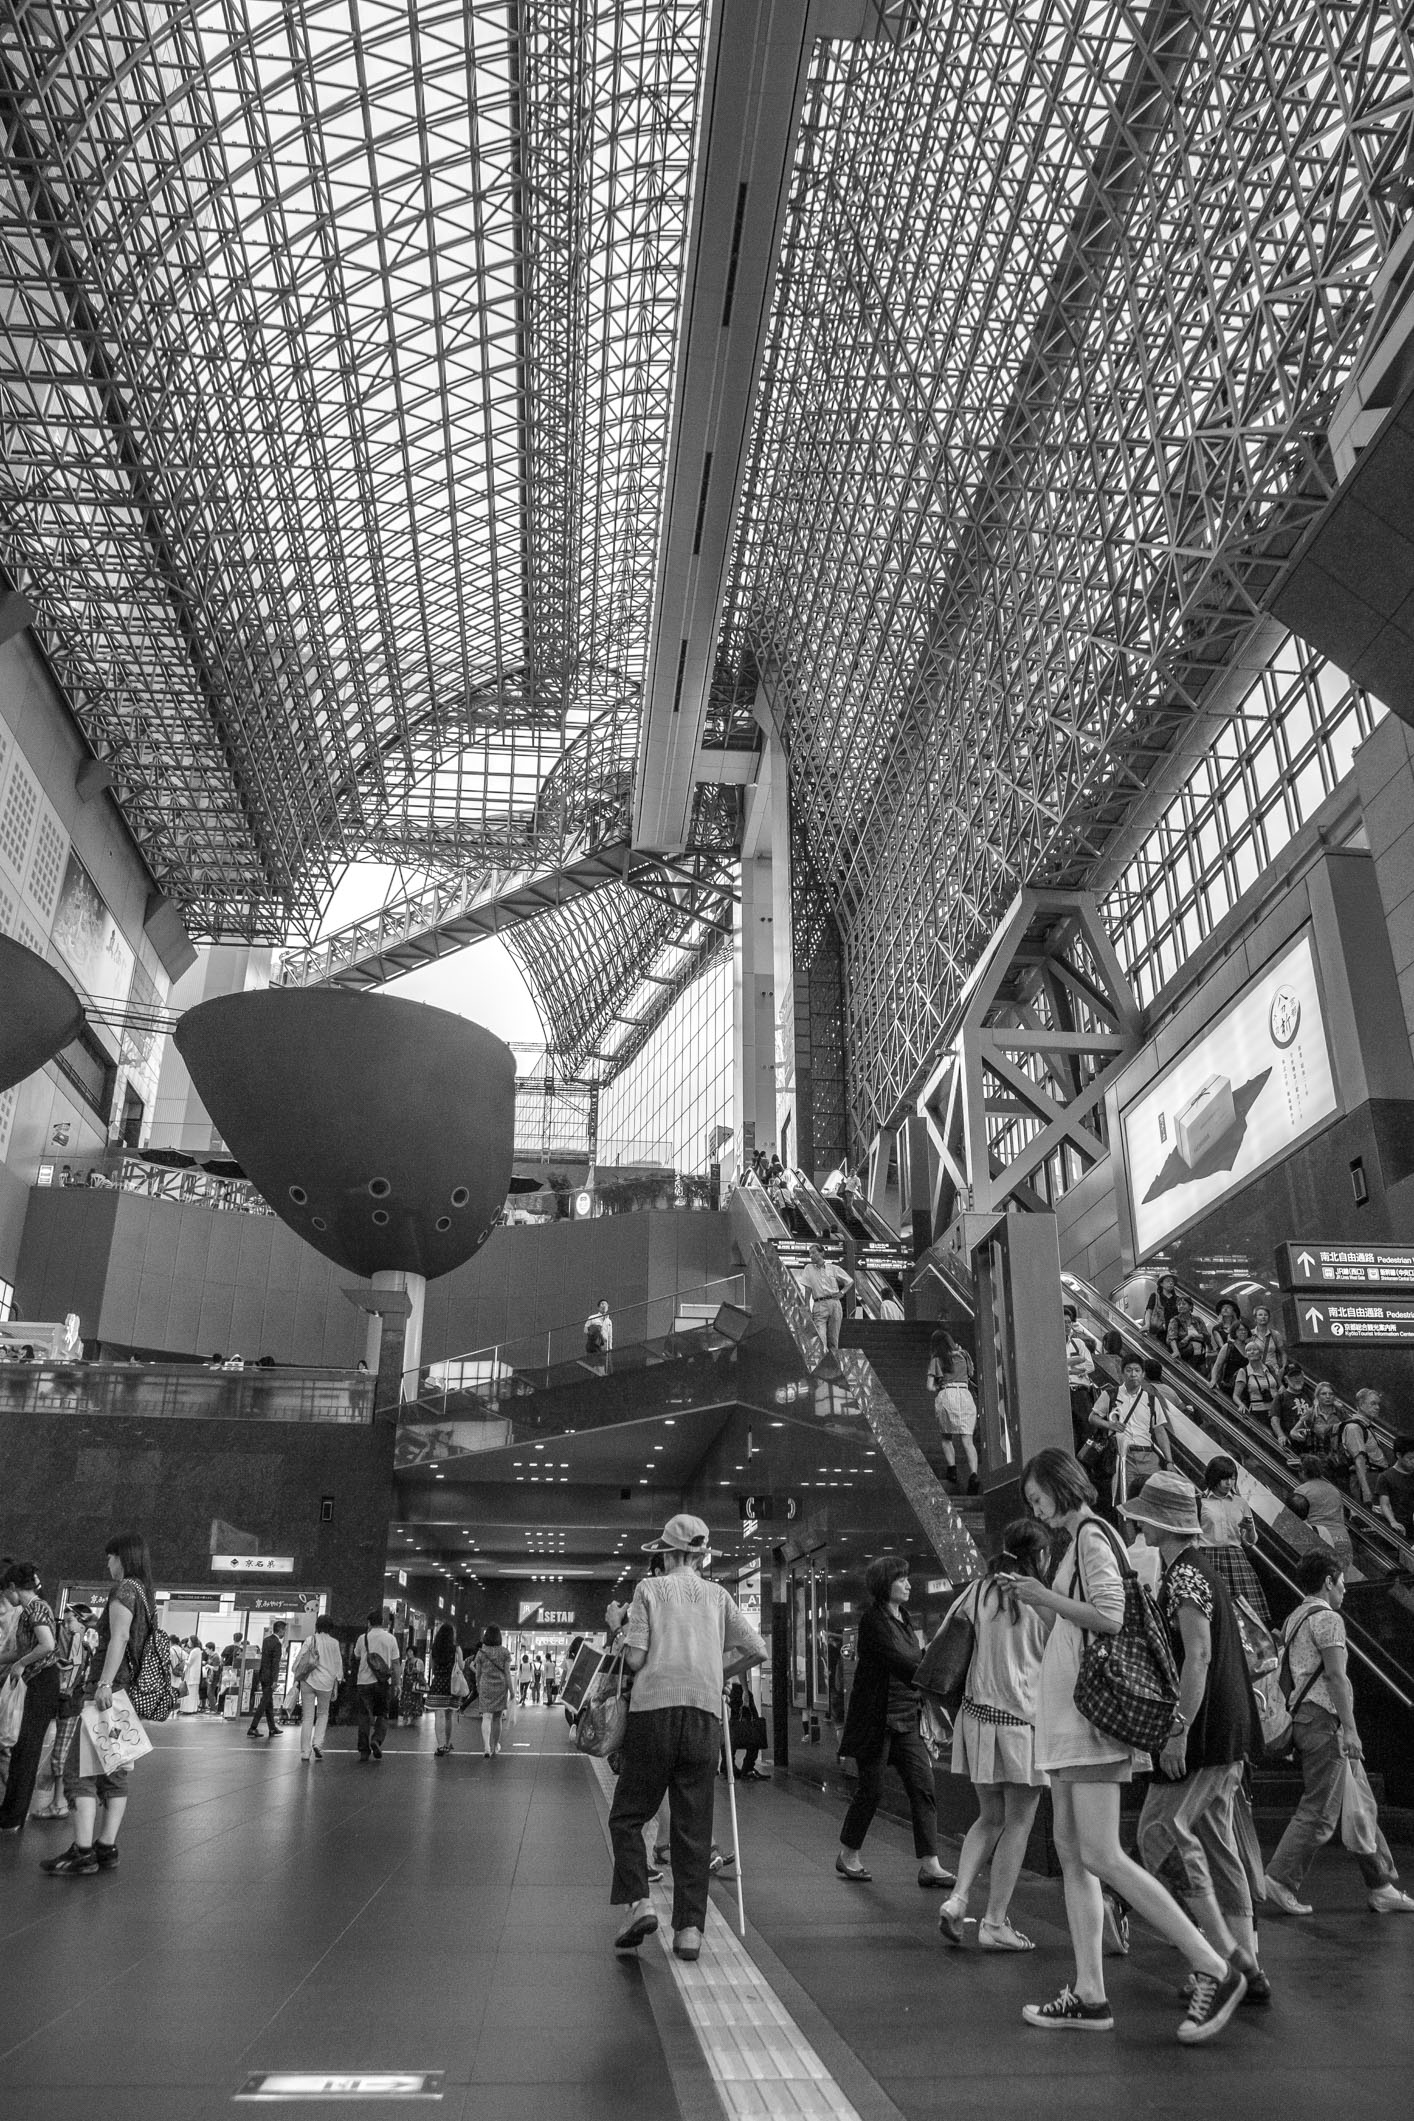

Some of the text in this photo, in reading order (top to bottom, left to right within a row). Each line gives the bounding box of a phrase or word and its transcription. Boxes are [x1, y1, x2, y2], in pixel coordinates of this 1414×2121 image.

[1320, 1251, 1375, 1263] 南北自由通路
[1377, 1256, 1412, 1264] Pedestrian
[1328, 1307, 1384, 1318] 南北自由通路
[255, 1599, 284, 1608] 京みやげ
[523, 1605, 575, 1623] JR ISETAN
